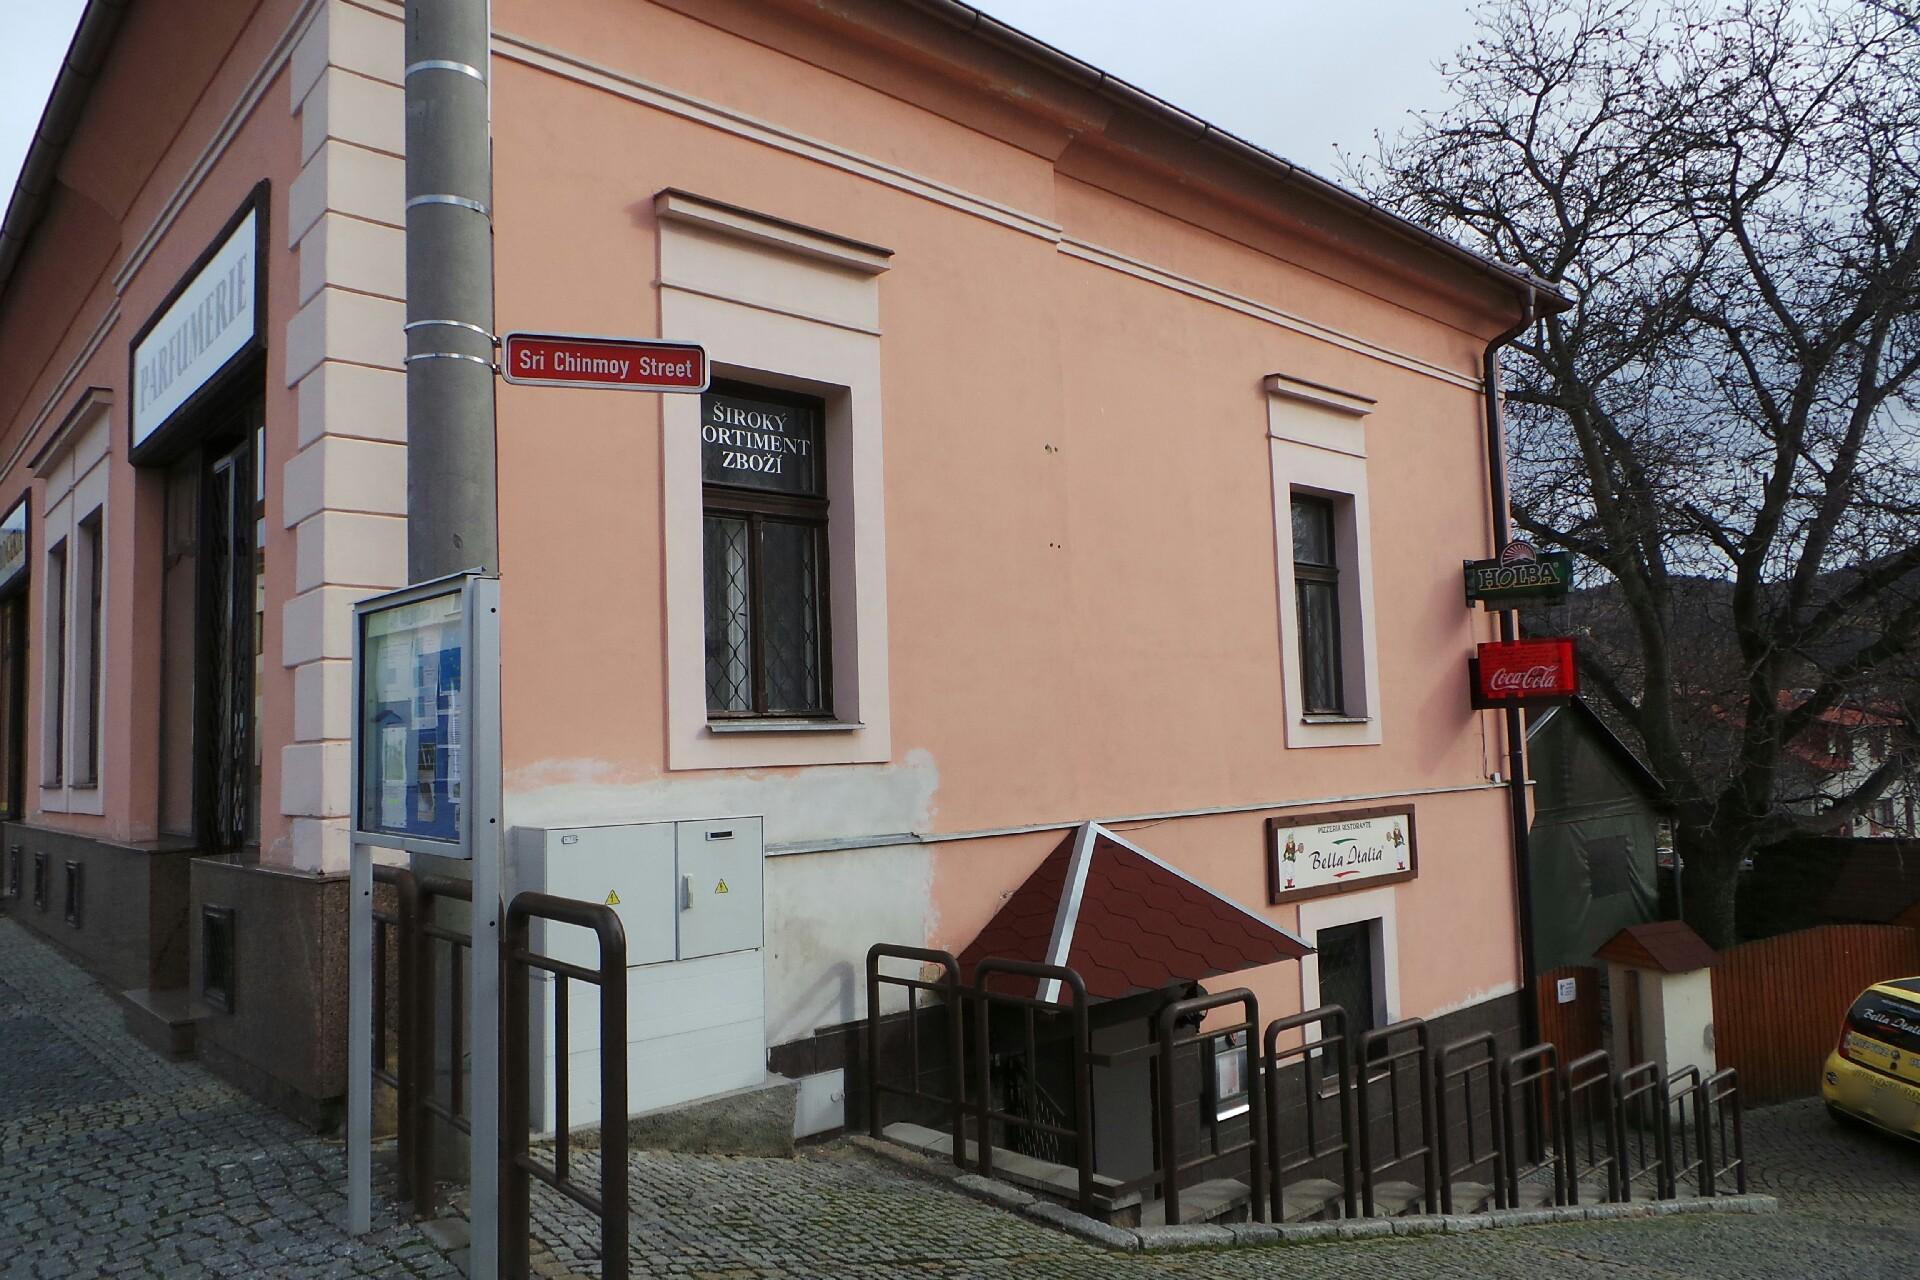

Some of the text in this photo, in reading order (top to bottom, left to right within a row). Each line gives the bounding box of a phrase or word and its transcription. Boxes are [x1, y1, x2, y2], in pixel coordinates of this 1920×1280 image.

[140, 253, 248, 415] PARFUMERIE
[519, 349, 693, 379] Sri Chinmoy Street
[713, 401, 787, 433] ŠIROKÝ
[722, 451, 783, 474] ZBOŽÍ
[1478, 562, 1560, 591] HOLBA
[1491, 665, 1559, 691] Coca-Cola
[1318, 825, 1341, 834] PIZZERIA
[1308, 845, 1383, 870] Bella Italia
[1863, 1008, 1890, 1024] Bella
